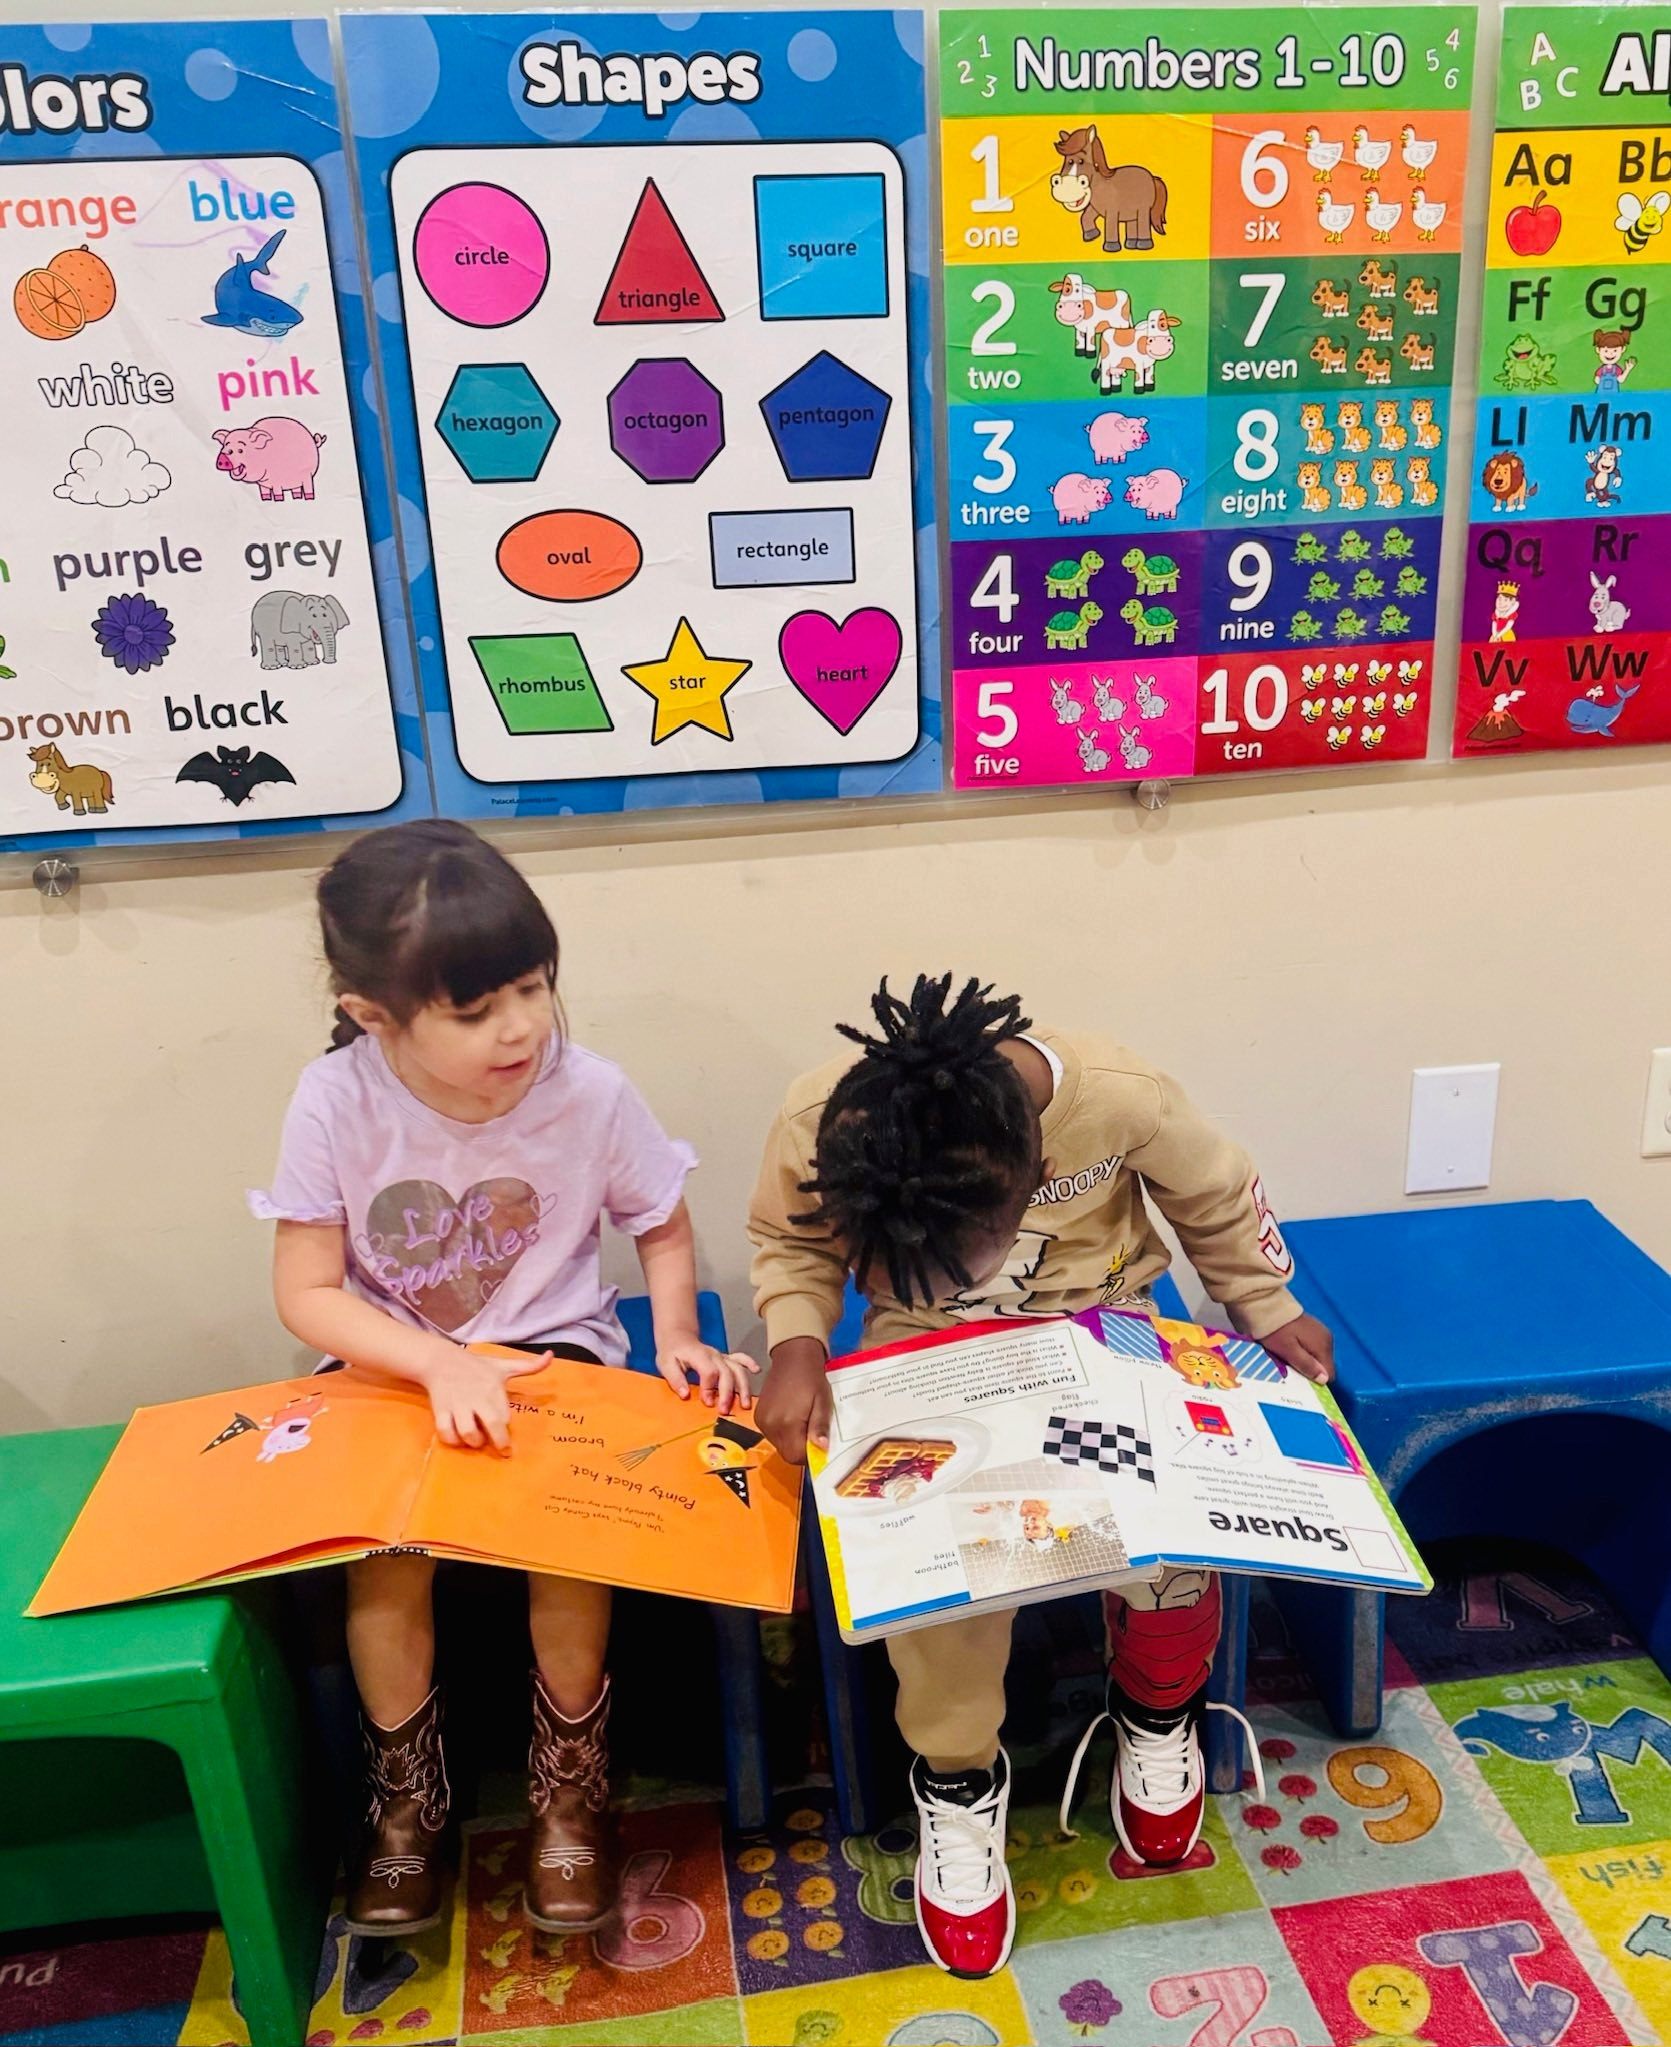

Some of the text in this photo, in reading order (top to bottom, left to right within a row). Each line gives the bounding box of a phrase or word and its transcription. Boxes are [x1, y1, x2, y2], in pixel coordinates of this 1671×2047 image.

[977, 34, 992, 59] 1
[1446, 28, 1460, 51] 4
[1531, 32, 1557, 66] A
[957, 61, 975, 84] 2
[1014, 33, 1405, 91] Numbers 1-10
[1425, 49, 1440, 72] 5
[519, 40, 762, 119] Shapes
[980, 74, 998, 98] 3
[1444, 68, 1459, 90] 6
[1519, 79, 1542, 111] B
[1556, 66, 1579, 98] C
[0, 63, 152, 135] lors
[969, 135, 1014, 213] 1
[1240, 130, 1289, 208] 6
[1504, 143, 1573, 187] Aa
[188, 177, 296, 223] blue
[964, 226, 1020, 248] one
[1245, 216, 1281, 241] six
[454, 247, 510, 266] circle
[787, 239, 858, 263] square
[618, 288, 701, 312] triangle
[1239, 273, 1287, 348] 7
[1507, 276, 1553, 322] Ff
[1584, 277, 1648, 333] Gg
[970, 281, 1018, 356] 2
[38, 362, 175, 409] white
[218, 356, 320, 412] pink
[968, 369, 1022, 390] two
[1221, 357, 1298, 382] seven
[452, 411, 544, 435] hexagon
[624, 409, 709, 433] octagon
[779, 405, 875, 429] pentagon
[1568, 403, 1653, 444] Mm
[972, 420, 1018, 494] 3
[1233, 408, 1280, 482] 8
[961, 503, 1031, 526] three
[1221, 488, 1288, 519] eight
[244, 538, 343, 581] grey
[547, 547, 592, 566] oval
[736, 538, 830, 561] rectangle
[1477, 528, 1545, 578] Qq
[1592, 524, 1640, 563] Rr
[54, 537, 203, 592] purple
[1227, 540, 1274, 612] 9
[969, 555, 1020, 623] 4
[969, 632, 1024, 654] four
[1220, 618, 1276, 641] nine
[816, 664, 869, 684] heart
[1473, 650, 1530, 688] Vv
[1566, 643, 1650, 682] Ww
[499, 675, 587, 696] rhombus
[669, 672, 707, 690] star
[164, 690, 289, 732] black
[975, 682, 1019, 748] 5
[1201, 664, 1289, 735] 10
[974, 754, 1020, 775] five
[1223, 741, 1263, 760] ten
[1027, 1155, 1125, 1208] SNOOPY
[403, 1193, 495, 1250] Love
[372, 1223, 541, 1306] Sparkles
[964, 1374, 1076, 1402] Fun with Squares
[508, 1402, 539, 1414] witc
[562, 1412, 584, 1425] I'm
[1052, 1399, 1099, 1413] checkered
[569, 1463, 696, 1510] Pointy black hat.
[880, 1514, 916, 1529] waffles
[1208, 1510, 1349, 1552] Square
[914, 1559, 960, 1576] bathroom
[934, 1551, 956, 1562] tiles
[1579, 1854, 1667, 1890] fish
